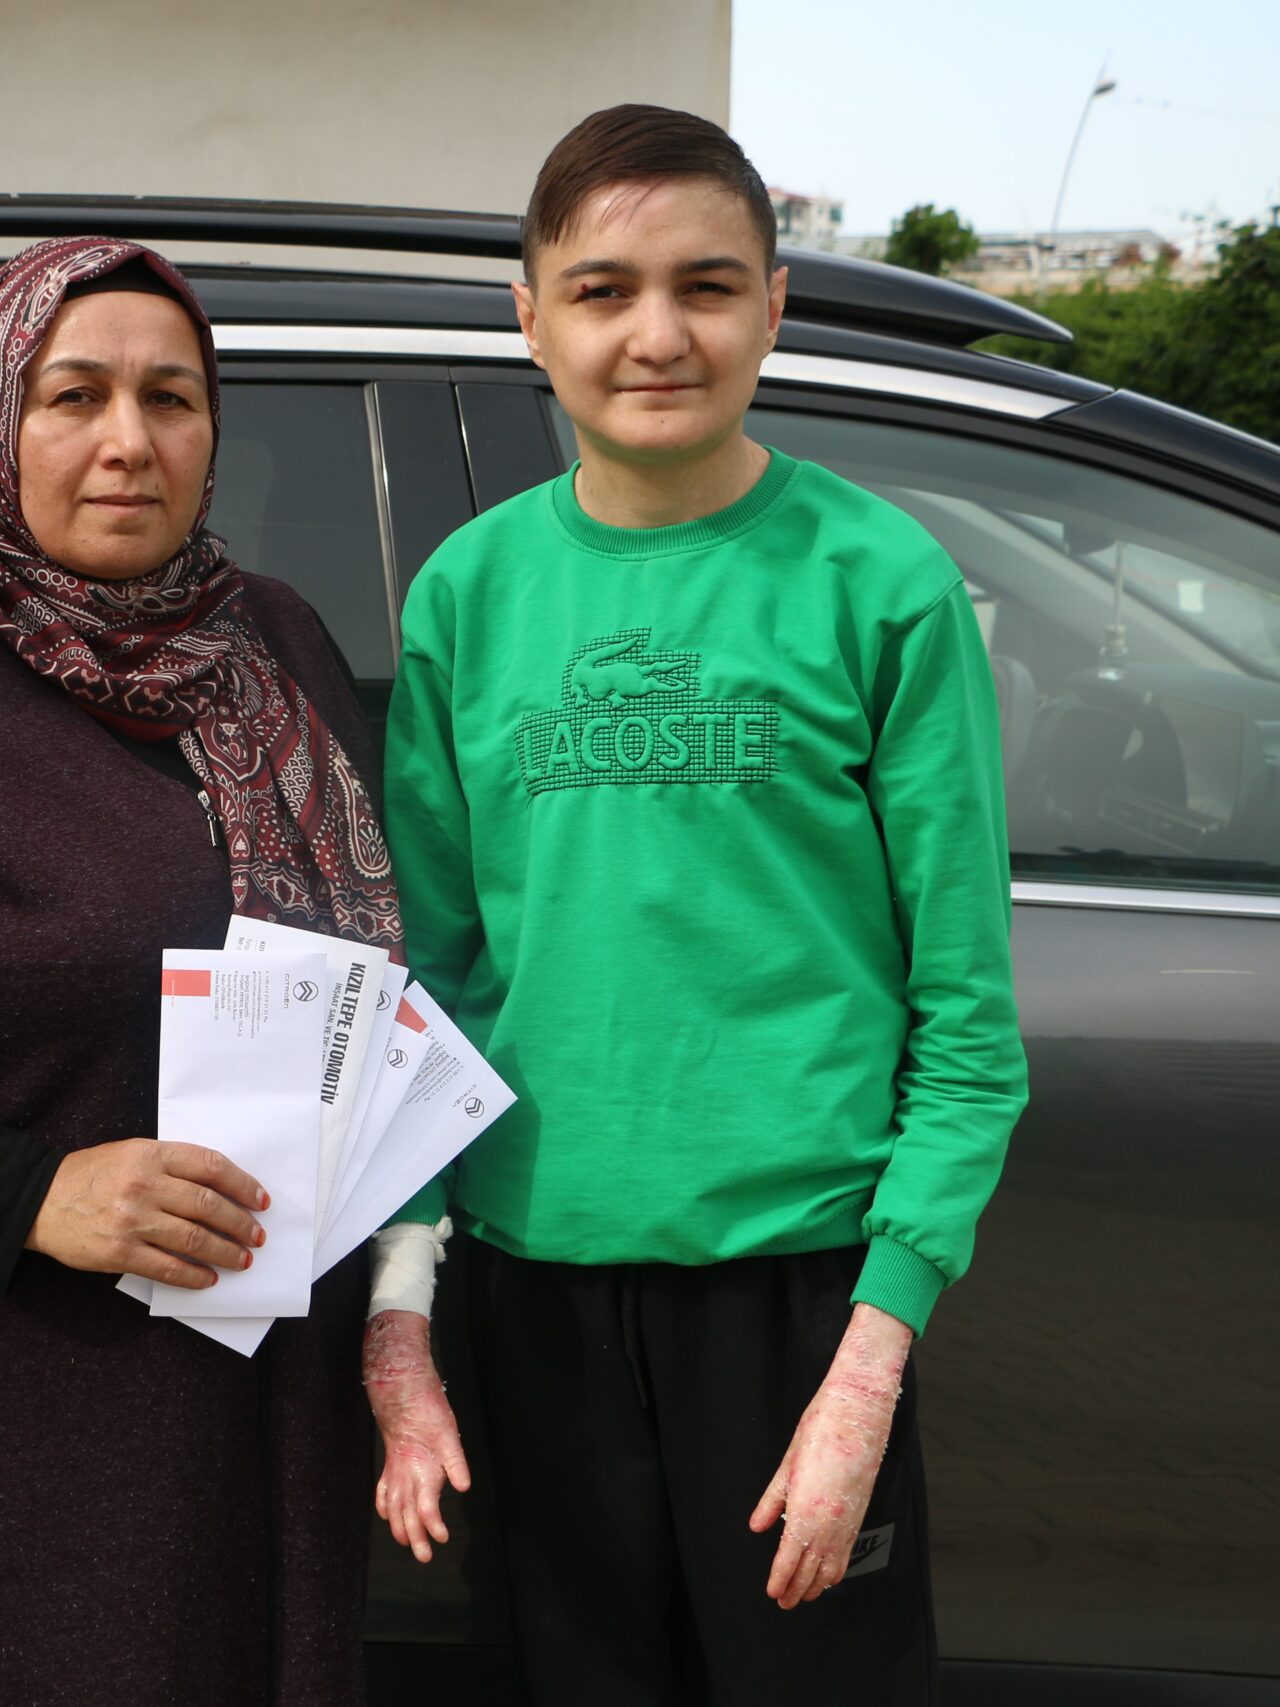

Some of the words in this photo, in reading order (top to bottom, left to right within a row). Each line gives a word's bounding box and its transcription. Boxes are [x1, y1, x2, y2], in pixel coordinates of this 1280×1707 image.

[523, 713, 765, 781] LACOSTE
[337, 962, 367, 1030] KIZILTEPE
[324, 1026, 332, 1035] VE
[320, 1031, 350, 1106] OTOMOTİV
[854, 1534, 880, 1554] IKE
